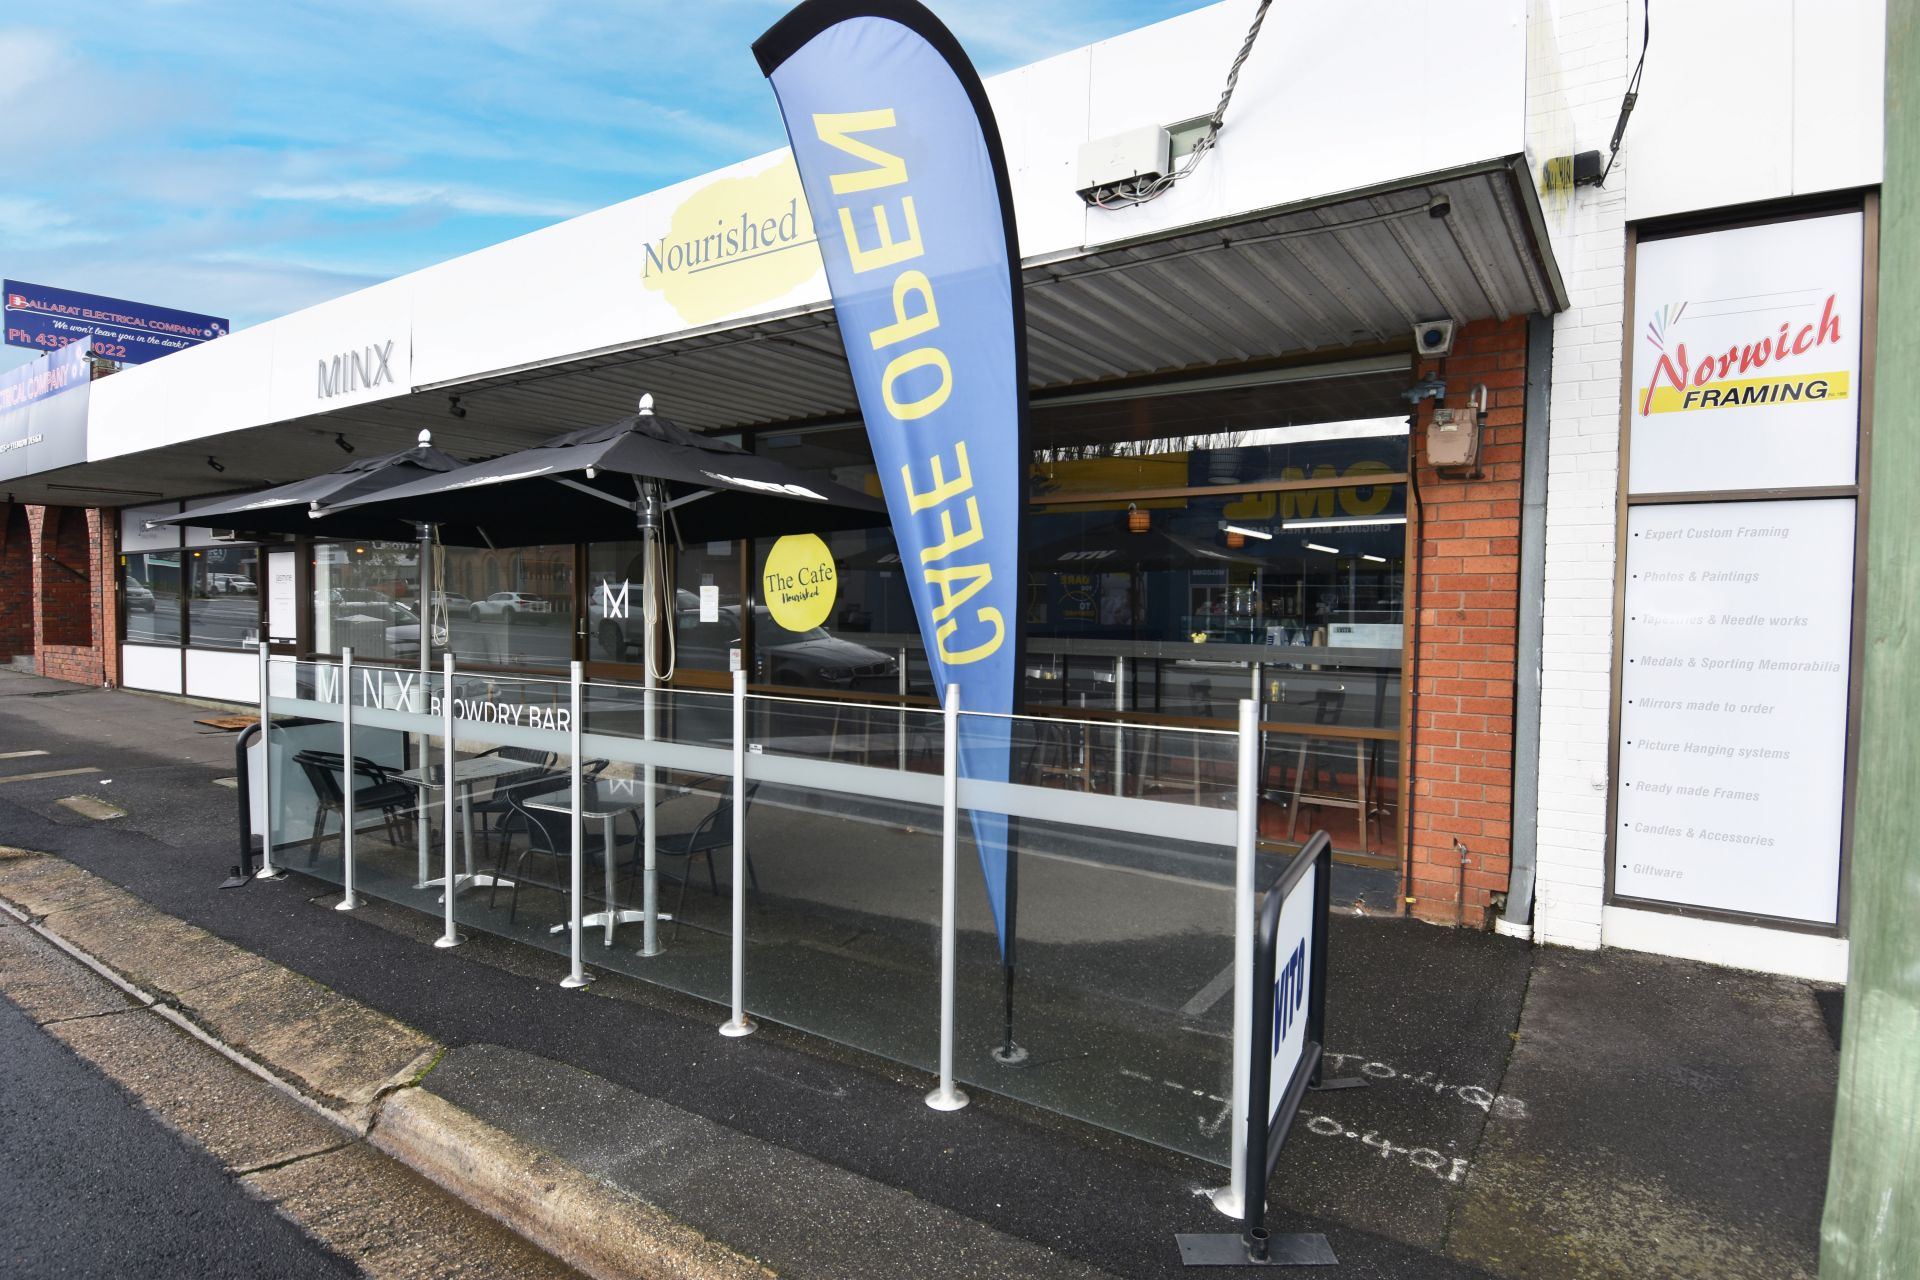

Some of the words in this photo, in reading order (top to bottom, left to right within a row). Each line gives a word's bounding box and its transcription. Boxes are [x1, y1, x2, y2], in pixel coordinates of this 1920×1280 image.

[642, 198, 798, 278] Nourished
[82, 308, 147, 328] ELECTRICAL
[148, 320, 202, 336] COMPANY
[9, 328, 31, 343] Ph
[70, 324, 93, 334] won't
[94, 327, 117, 338] leave
[118, 332, 135, 342] you
[136, 334, 146, 342] in
[147, 335, 160, 345] the
[1641, 292, 1841, 417] Norwich
[317, 339, 394, 399] MINX
[1682, 379, 1829, 409] FRAMING
[1644, 527, 1684, 541] Expert
[1686, 526, 1733, 540] Custom
[1736, 525, 1790, 539] Framing
[766, 573, 793, 592] The
[798, 563, 833, 586] Cafe
[1642, 570, 1684, 582] Photos
[1688, 571, 1697, 582] &
[1701, 570, 1760, 583] Paintings
[1708, 614, 1717, 626] &
[1720, 614, 1765, 627] Needle
[1769, 615, 1808, 627] works
[1640, 656, 1684, 668] Medals
[1688, 657, 1697, 669] &
[1701, 657, 1754, 672] Sporting
[1758, 659, 1840, 673] Memorabilia
[1638, 697, 1683, 710] Mirrors
[1686, 699, 1720, 712] made
[1724, 701, 1736, 713] to
[1740, 702, 1775, 715] order
[529, 706, 571, 733] BAR
[1637, 739, 1680, 753] Picture
[1683, 741, 1734, 758] Hanging
[1738, 747, 1791, 760] systems
[1635, 780, 1673, 795] Ready
[1676, 784, 1710, 798] made
[1713, 787, 1760, 802] Frames
[1634, 822, 1682, 838] Candles
[1686, 827, 1695, 838] &
[1698, 829, 1775, 848] Accessories
[1633, 863, 1683, 880] Giftware
[1273, 937, 1305, 1058] VITO
